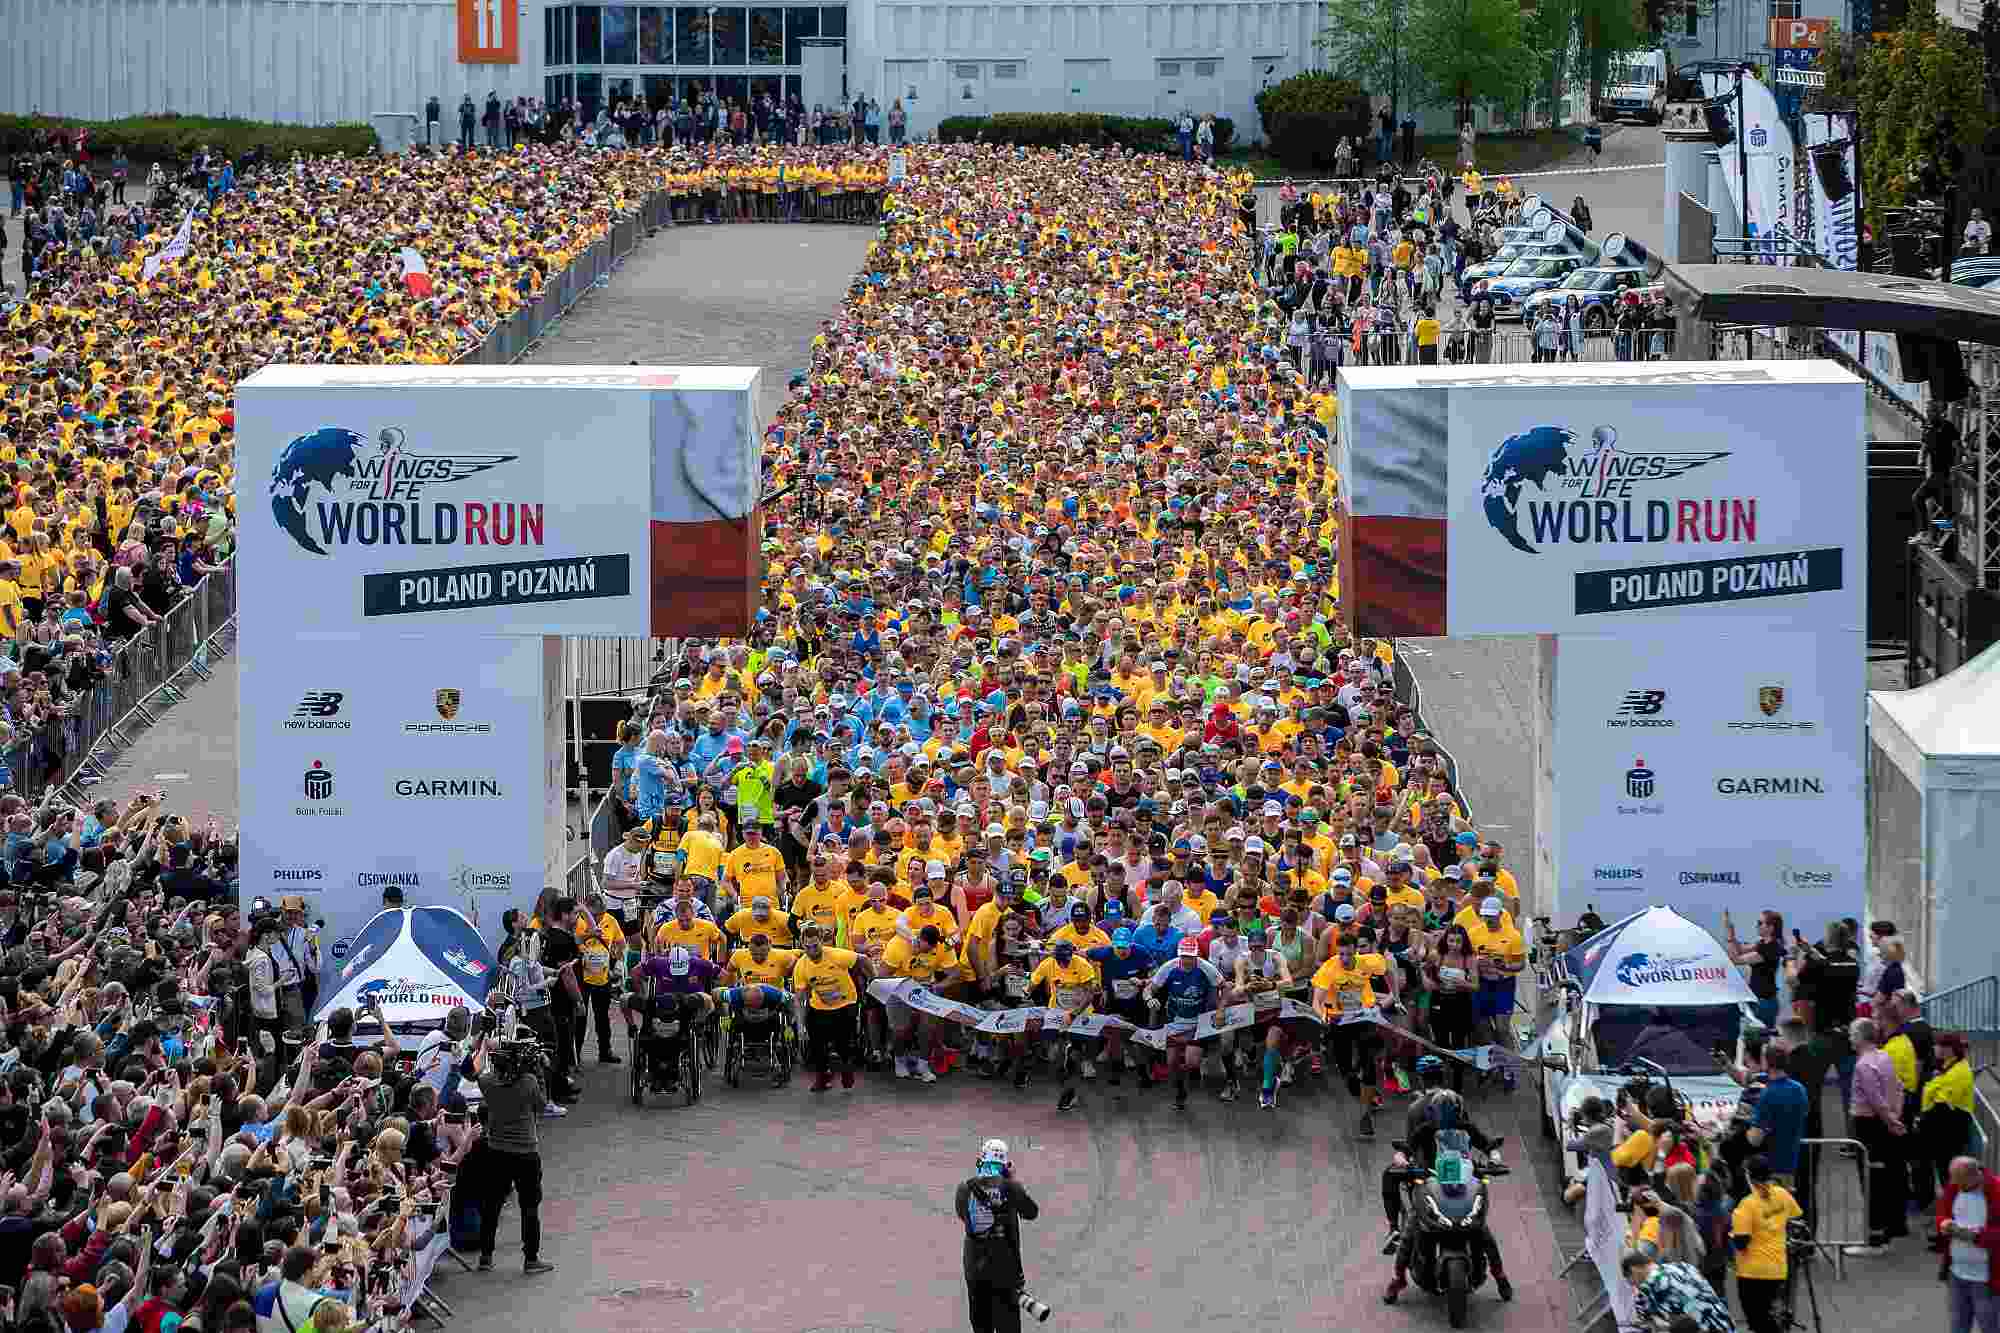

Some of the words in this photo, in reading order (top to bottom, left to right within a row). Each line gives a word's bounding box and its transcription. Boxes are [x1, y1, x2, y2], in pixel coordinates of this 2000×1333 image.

[369, 480, 424, 500] LIFE
[1580, 478, 1638, 498] LIFE
[318, 502, 458, 545] WORLD
[464, 502, 543, 545] RUN
[1529, 500, 1670, 543] WORLD
[1677, 499, 1758, 543] RUN
[400, 572, 492, 608] POLAND
[501, 558, 595, 598] POZNAŃ
[1610, 569, 1704, 604] POLAND
[1712, 552, 1809, 594] POZNAŃ
[273, 869, 322, 880] PHILIPS
[1634, 968, 1691, 984] WORLD
[1695, 966, 1727, 982] RUN
[375, 993, 429, 1004] WORLD
[431, 994, 464, 1007] RUN
